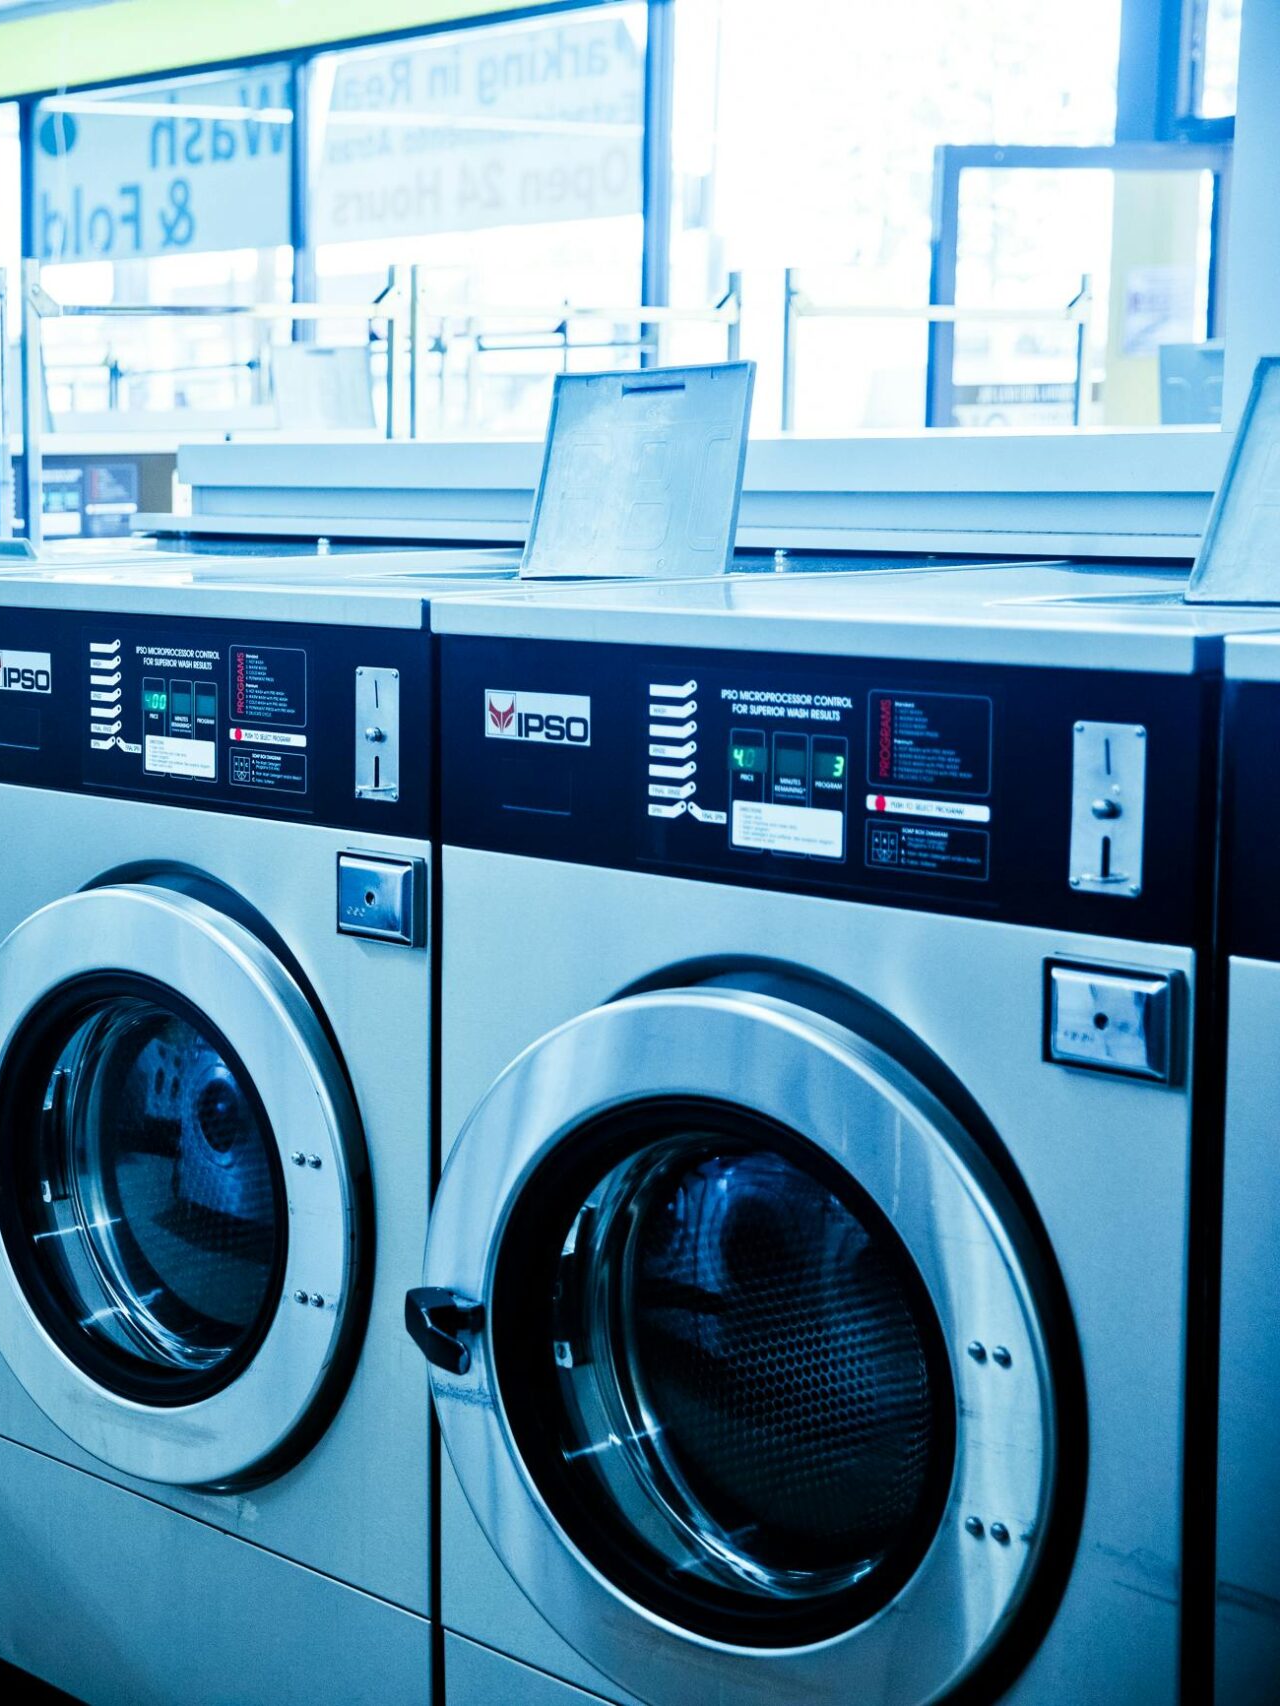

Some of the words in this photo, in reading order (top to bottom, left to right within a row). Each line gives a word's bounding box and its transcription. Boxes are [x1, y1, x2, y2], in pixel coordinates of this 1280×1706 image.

[148, 647, 194, 658] MICROPROCESSOR
[3, 667, 50, 691] IPSO
[721, 689, 738, 700] IPSO
[740, 690, 812, 705] MICROPROCESSOR
[814, 696, 853, 708] CONTROL
[732, 703, 748, 714] FOR
[749, 704, 785, 717] SUPERIOR
[786, 708, 808, 719] WASH
[810, 709, 840, 721] RESULTS
[518, 712, 588, 742] IPSO
[833, 756, 844, 777] 3
[815, 781, 842, 790] PROGRAM
